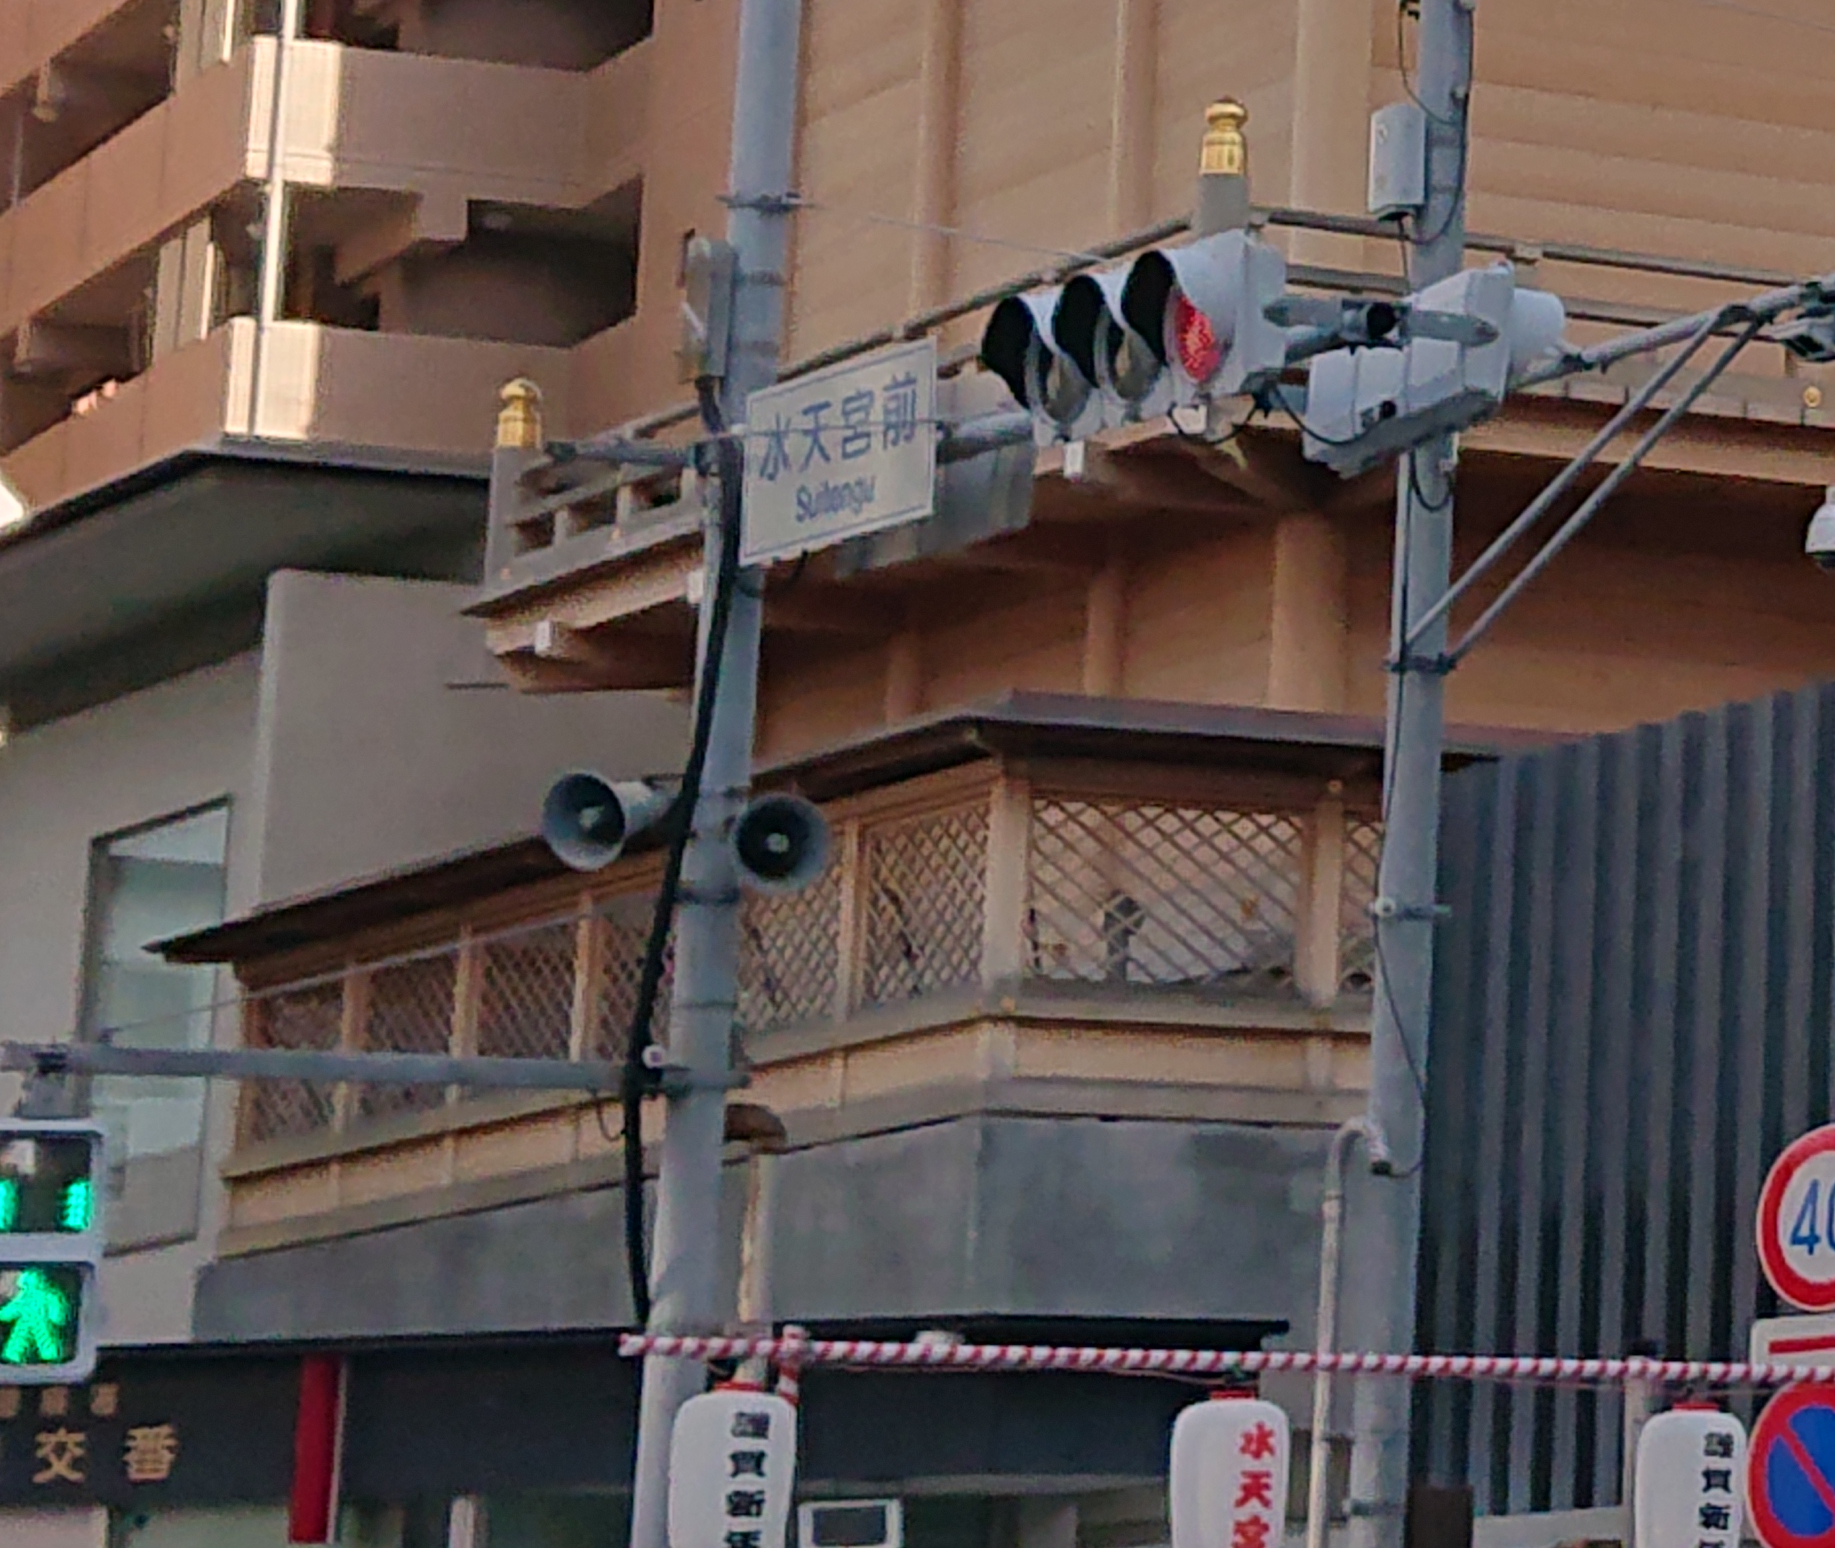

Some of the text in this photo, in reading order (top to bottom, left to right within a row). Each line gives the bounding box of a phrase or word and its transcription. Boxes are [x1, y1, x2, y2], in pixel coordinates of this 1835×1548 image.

[759, 371, 918, 481] 水天宮前
[31, 1422, 178, 1483] 交番
[1231, 1420, 1276, 1548] 水天宮
